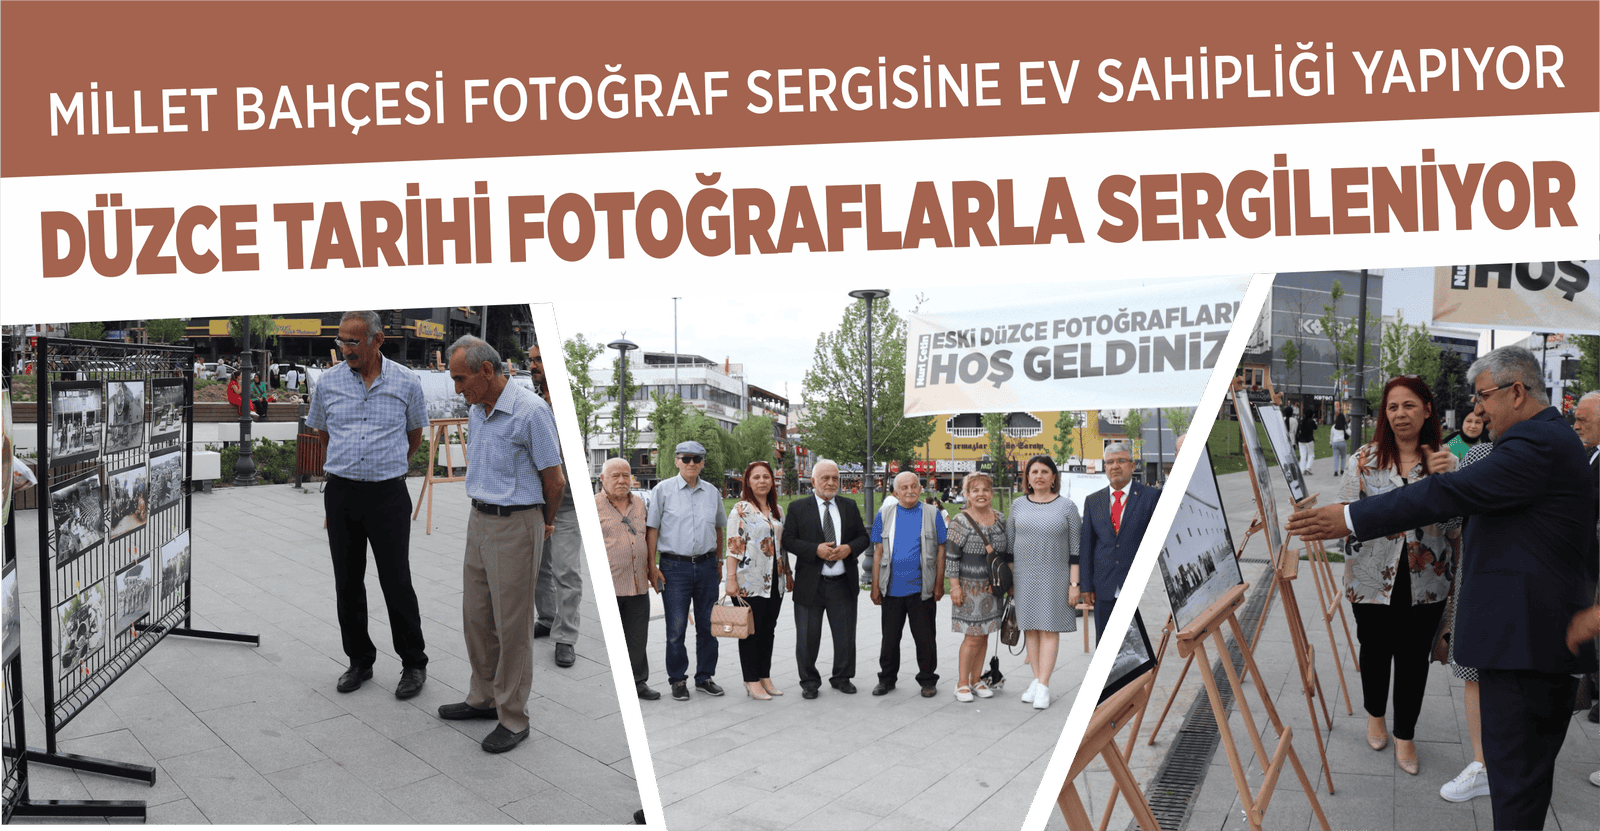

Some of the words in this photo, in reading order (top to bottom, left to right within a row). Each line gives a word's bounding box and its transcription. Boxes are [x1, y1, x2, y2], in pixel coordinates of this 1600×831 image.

[1474, 260, 1590, 302] HOŞ
[980, 321, 1048, 347] DÜZCE
[918, 335, 929, 362] Çetin
[916, 363, 926, 386] Nuri
[929, 349, 1014, 389] HOŞ
